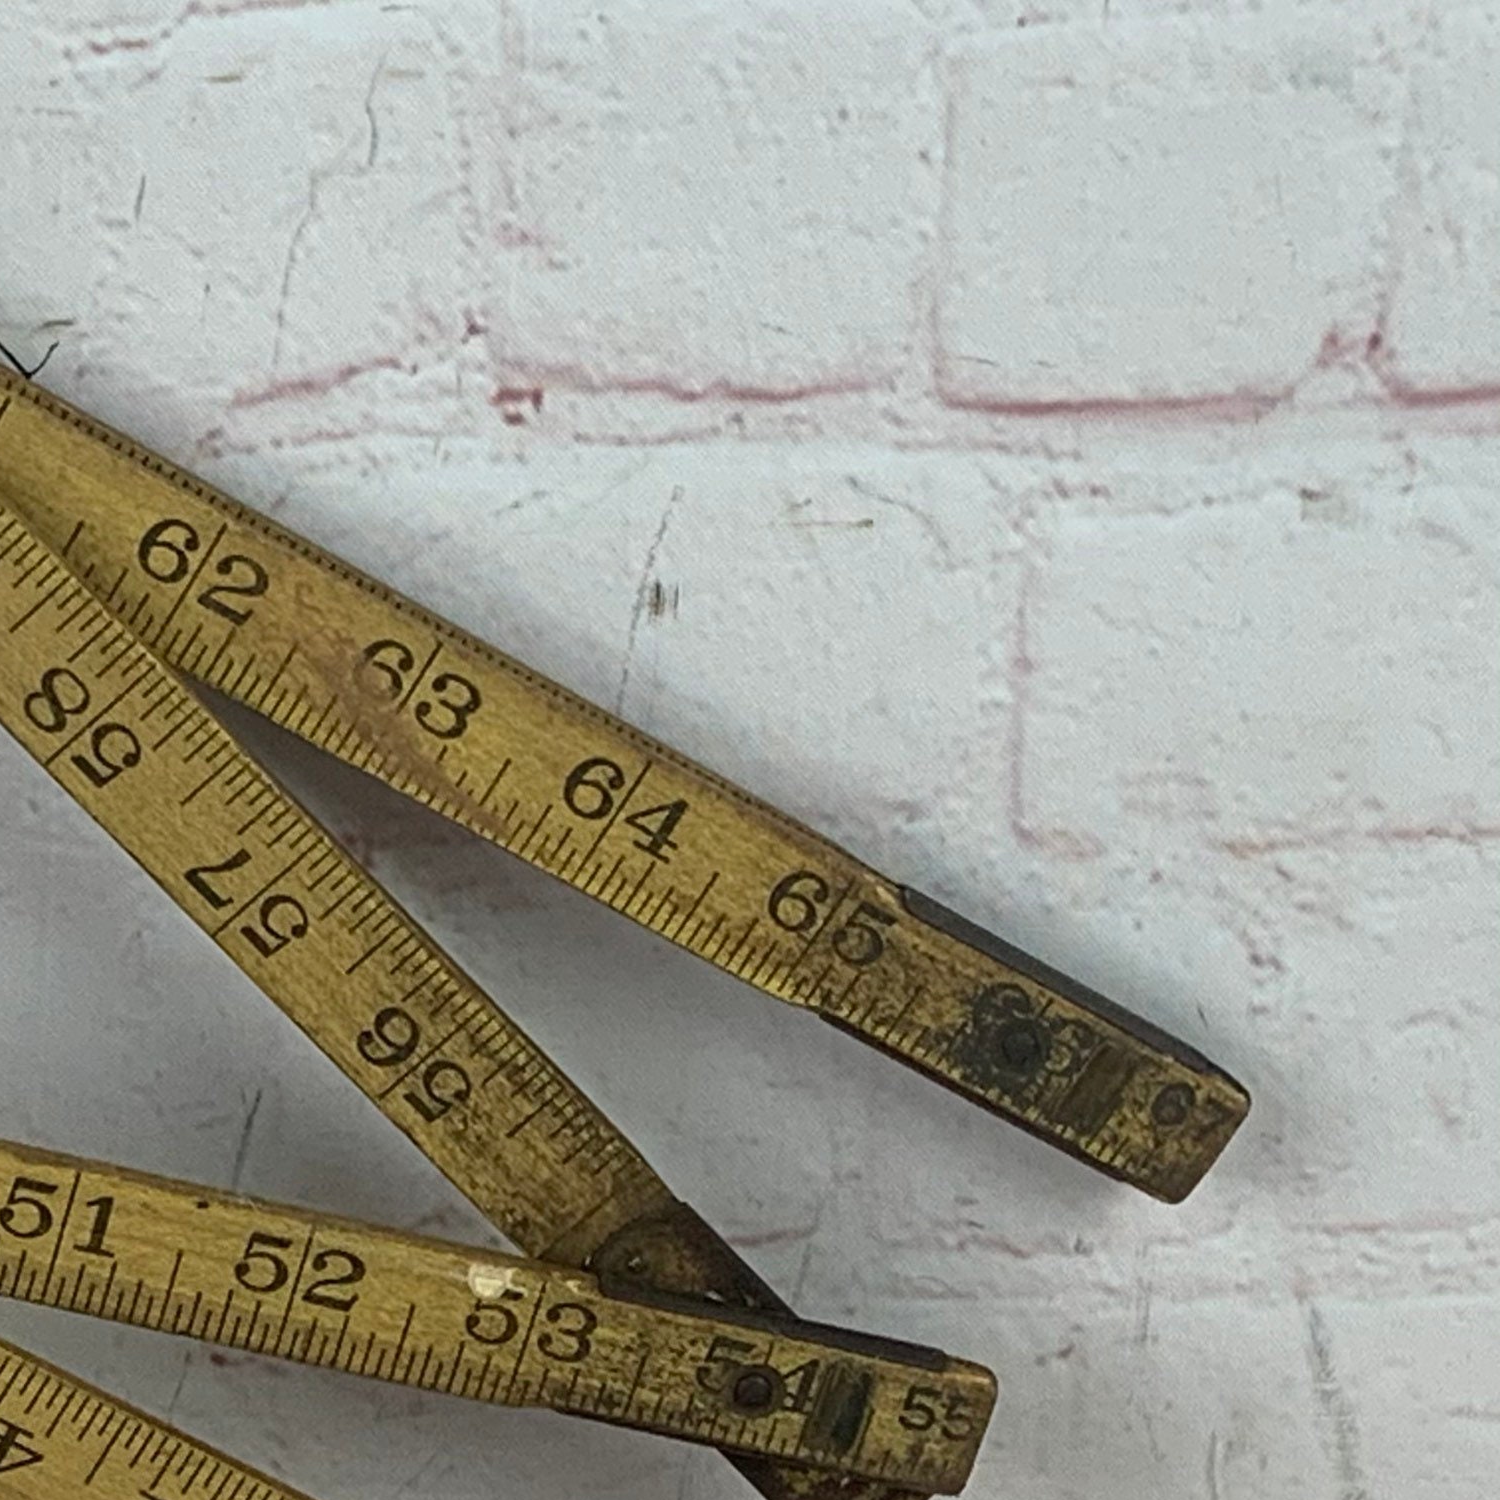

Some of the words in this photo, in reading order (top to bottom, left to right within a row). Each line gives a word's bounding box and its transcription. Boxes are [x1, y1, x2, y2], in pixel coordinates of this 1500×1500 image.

[22, 667, 142, 788] 58
[137, 518, 269, 626] 62
[353, 639, 482, 740] 63
[563, 756, 689, 865] 64
[768, 869, 897, 967] 65
[184, 848, 308, 959] 57
[357, 1006, 472, 1123] 56
[234, 1232, 366, 1312] 52
[466, 1284, 598, 1363] 53
[900, 1386, 975, 1441] 55
